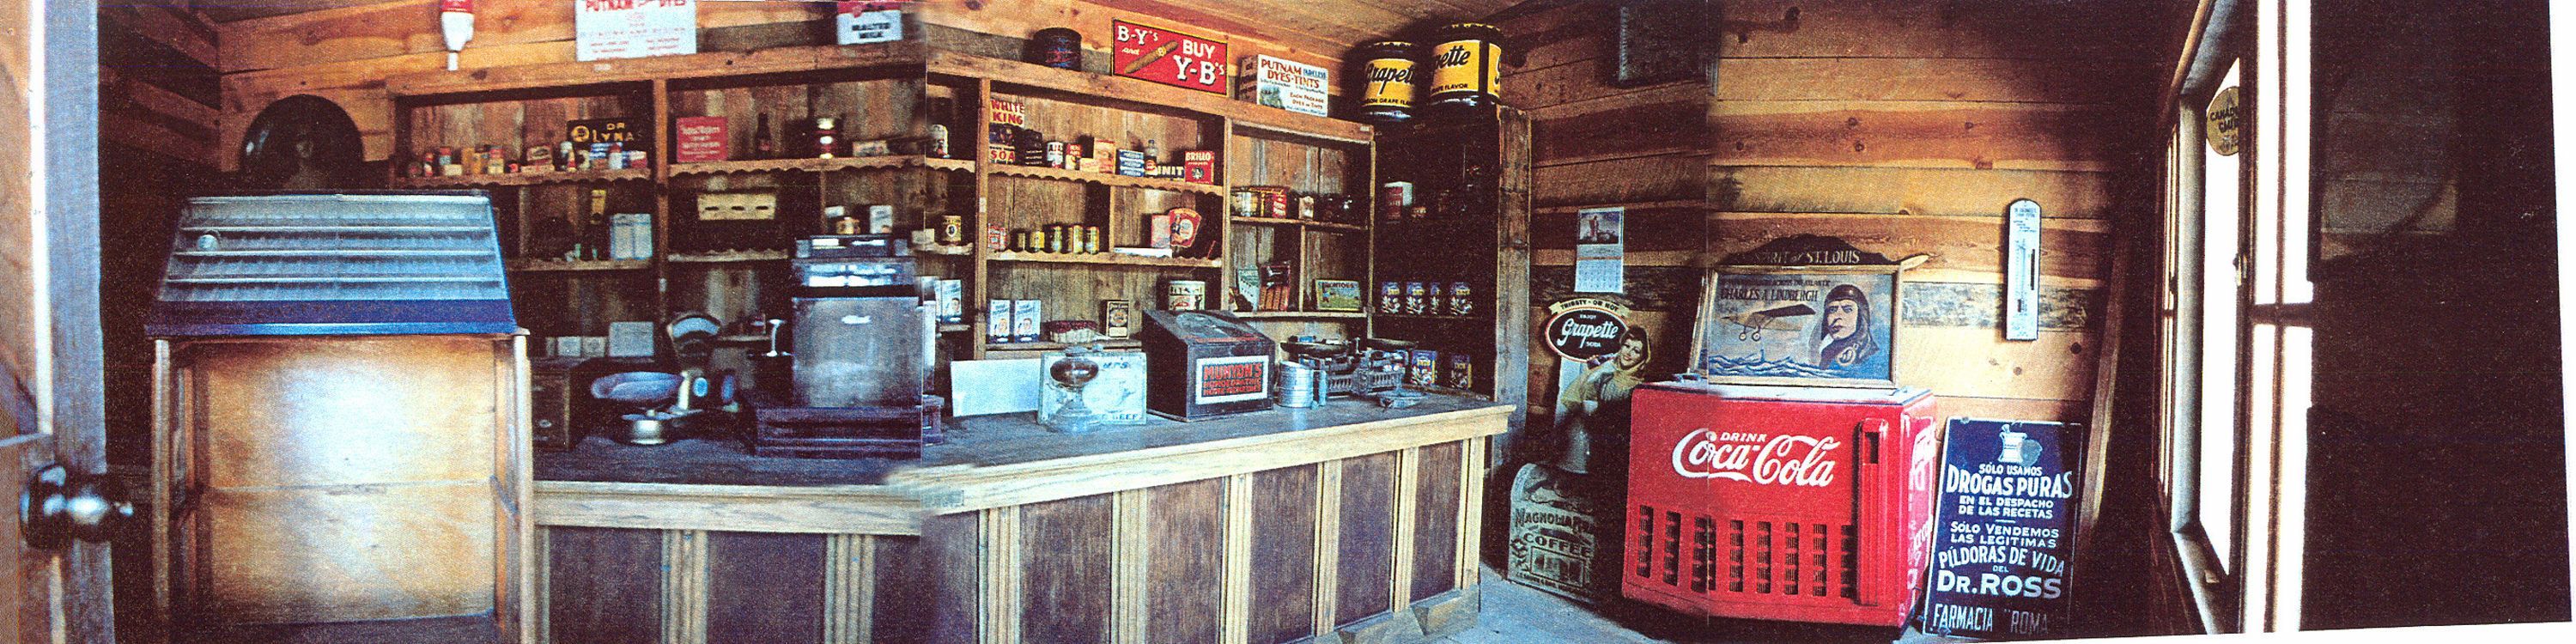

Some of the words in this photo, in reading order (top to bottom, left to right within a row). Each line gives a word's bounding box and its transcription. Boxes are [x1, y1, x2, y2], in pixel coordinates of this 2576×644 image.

[1182, 39, 1216, 59] BUY
[1261, 58, 1302, 75] PUTNAM
[992, 100, 1025, 113] WHITE
[993, 112, 1024, 125] KING
[990, 150, 1016, 163] SOA
[1185, 152, 1212, 161] BRILLO
[1825, 251, 1861, 264] LOUIS
[1557, 318, 1619, 349] Grapette
[1720, 432, 1767, 442] DRINK
[1672, 428, 1841, 487] Coca-Cola
[1978, 462, 2004, 475] SÓLO
[2007, 466, 2043, 477] USAMOS
[1946, 464, 2014, 495] DROGAS
[2018, 471, 2073, 498] PURAS
[1959, 495, 1975, 505] EN
[1978, 495, 1993, 506] EL
[1996, 497, 2054, 509] DESPACHO
[1959, 505, 1974, 515] DE
[1978, 506, 2000, 517] LAS
[2002, 507, 2053, 519] RECETAS
[1950, 521, 1981, 534] SÓLO
[1985, 523, 2059, 538] VENDEMOS
[1522, 532, 1594, 558] COFFEE
[1950, 533, 1974, 544] LAS
[1939, 546, 2006, 568] PÍLDORAS
[2009, 547, 2027, 566] DE
[2032, 550, 2065, 577] VIDA
[1980, 573, 2062, 599] ROSS
[1933, 603, 1993, 632] FARMACIA
